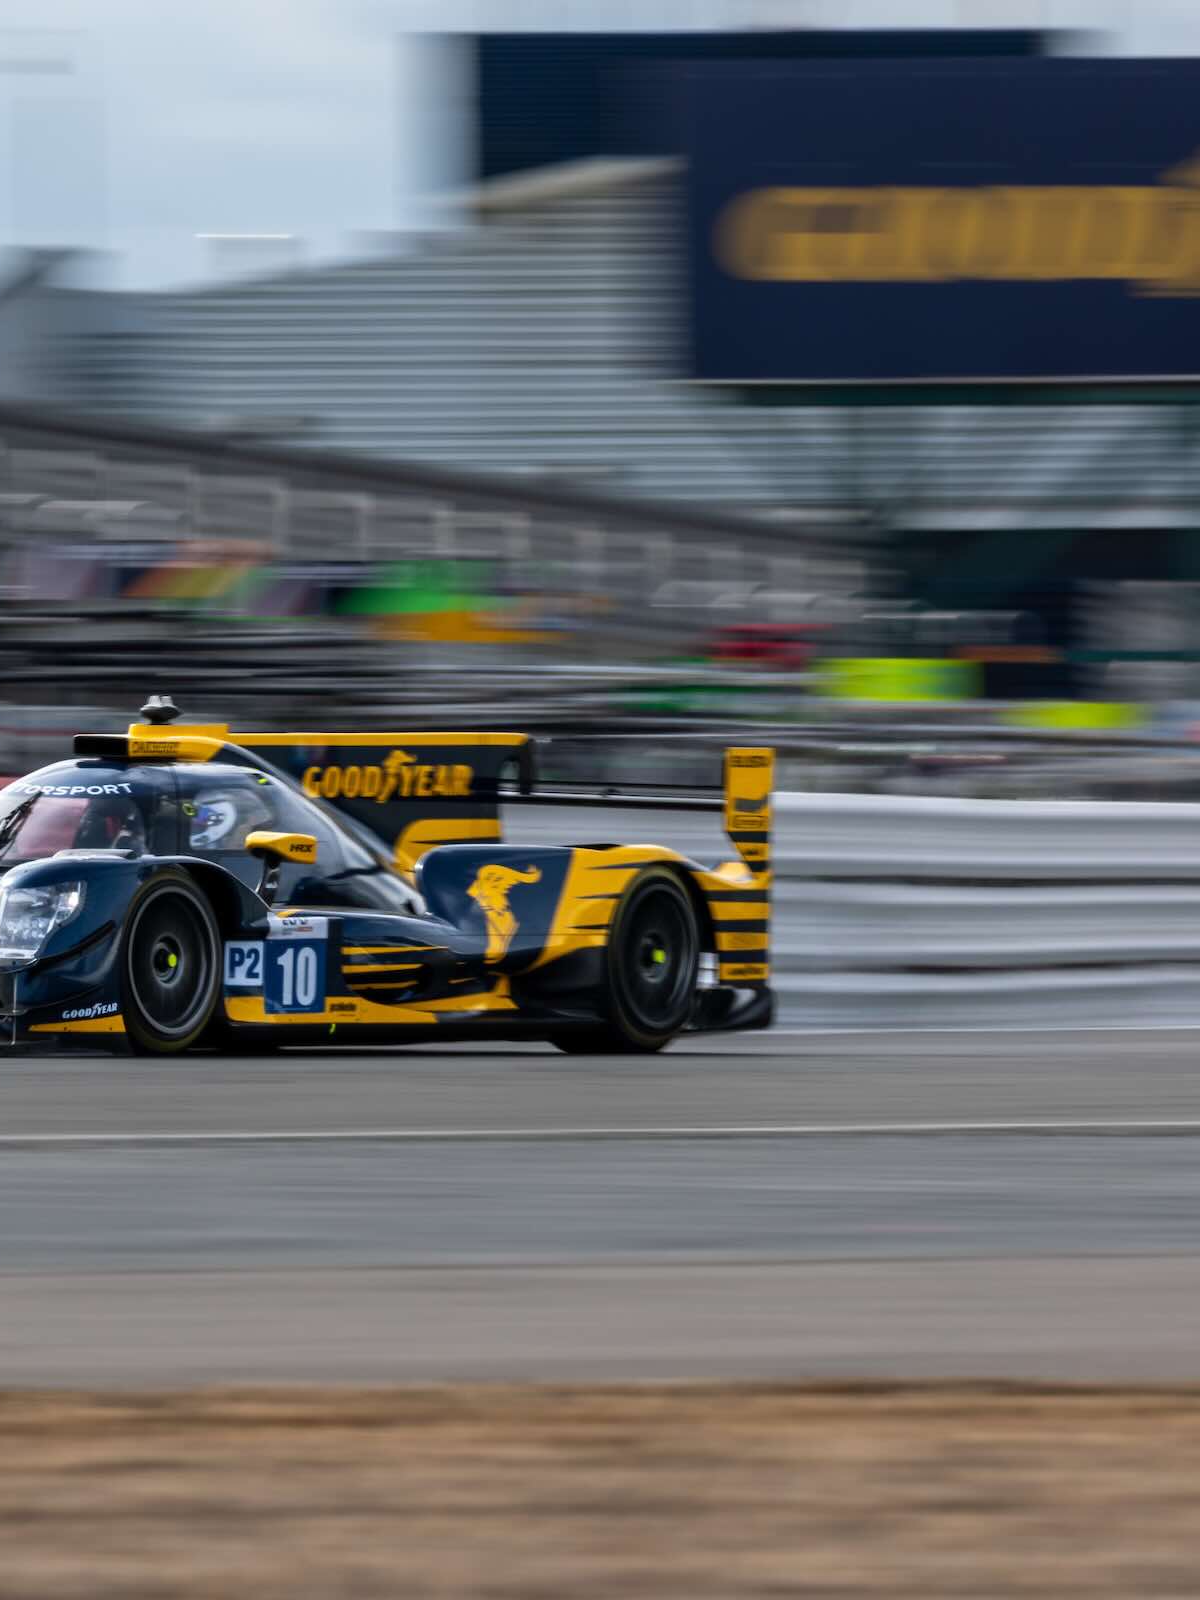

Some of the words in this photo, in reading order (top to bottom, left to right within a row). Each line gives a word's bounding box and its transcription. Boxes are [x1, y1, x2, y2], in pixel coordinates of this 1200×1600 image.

[228, 946, 261, 979] P2
[276, 946, 318, 1006] 10
[61, 1002, 118, 1019] GOODYEAR
